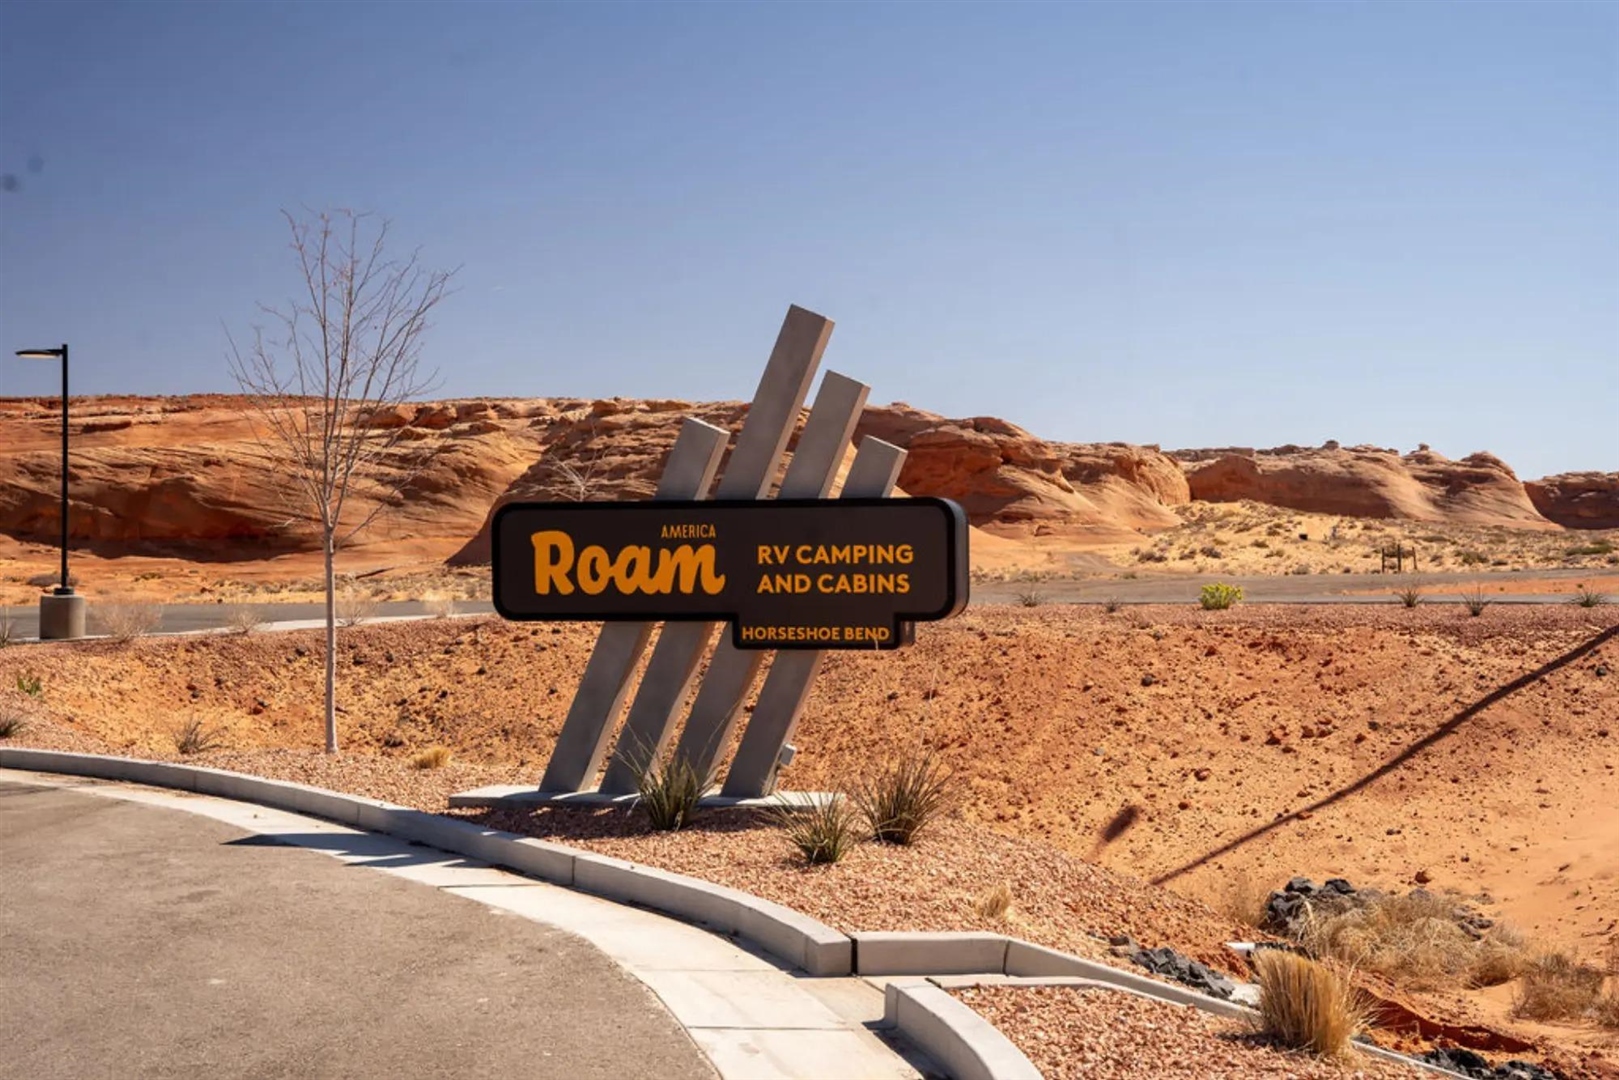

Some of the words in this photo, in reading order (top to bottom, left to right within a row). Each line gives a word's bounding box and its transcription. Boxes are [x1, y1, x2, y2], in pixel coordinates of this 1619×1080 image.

[661, 524, 716, 538] AMERICA
[531, 530, 725, 595] Roam
[757, 545, 790, 564] RV
[796, 545, 914, 564] CAMPING
[757, 574, 812, 593] AND
[817, 574, 910, 593] CABINS
[742, 627, 840, 641] HORSESHOE
[844, 628, 890, 641] BEND
